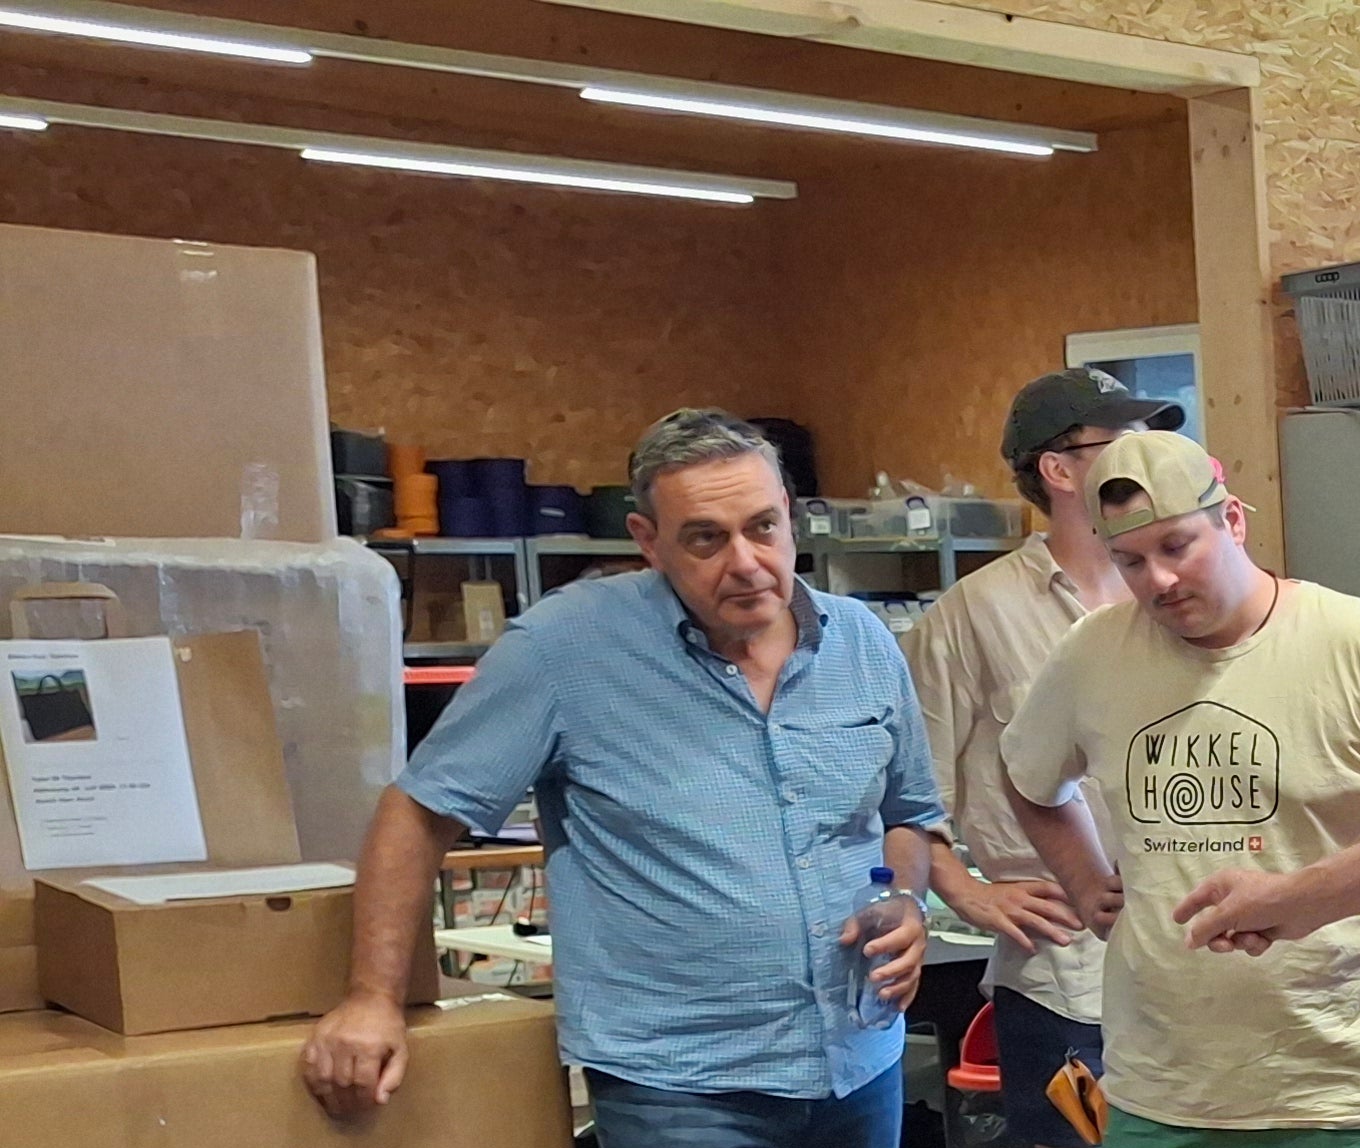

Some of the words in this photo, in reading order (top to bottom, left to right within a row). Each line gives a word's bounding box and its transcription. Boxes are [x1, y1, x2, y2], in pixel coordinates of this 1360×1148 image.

[1145, 732, 1262, 767] WIKKEL
[1144, 773, 1261, 821] HOUSE
[1143, 836, 1245, 853] Switzerland
